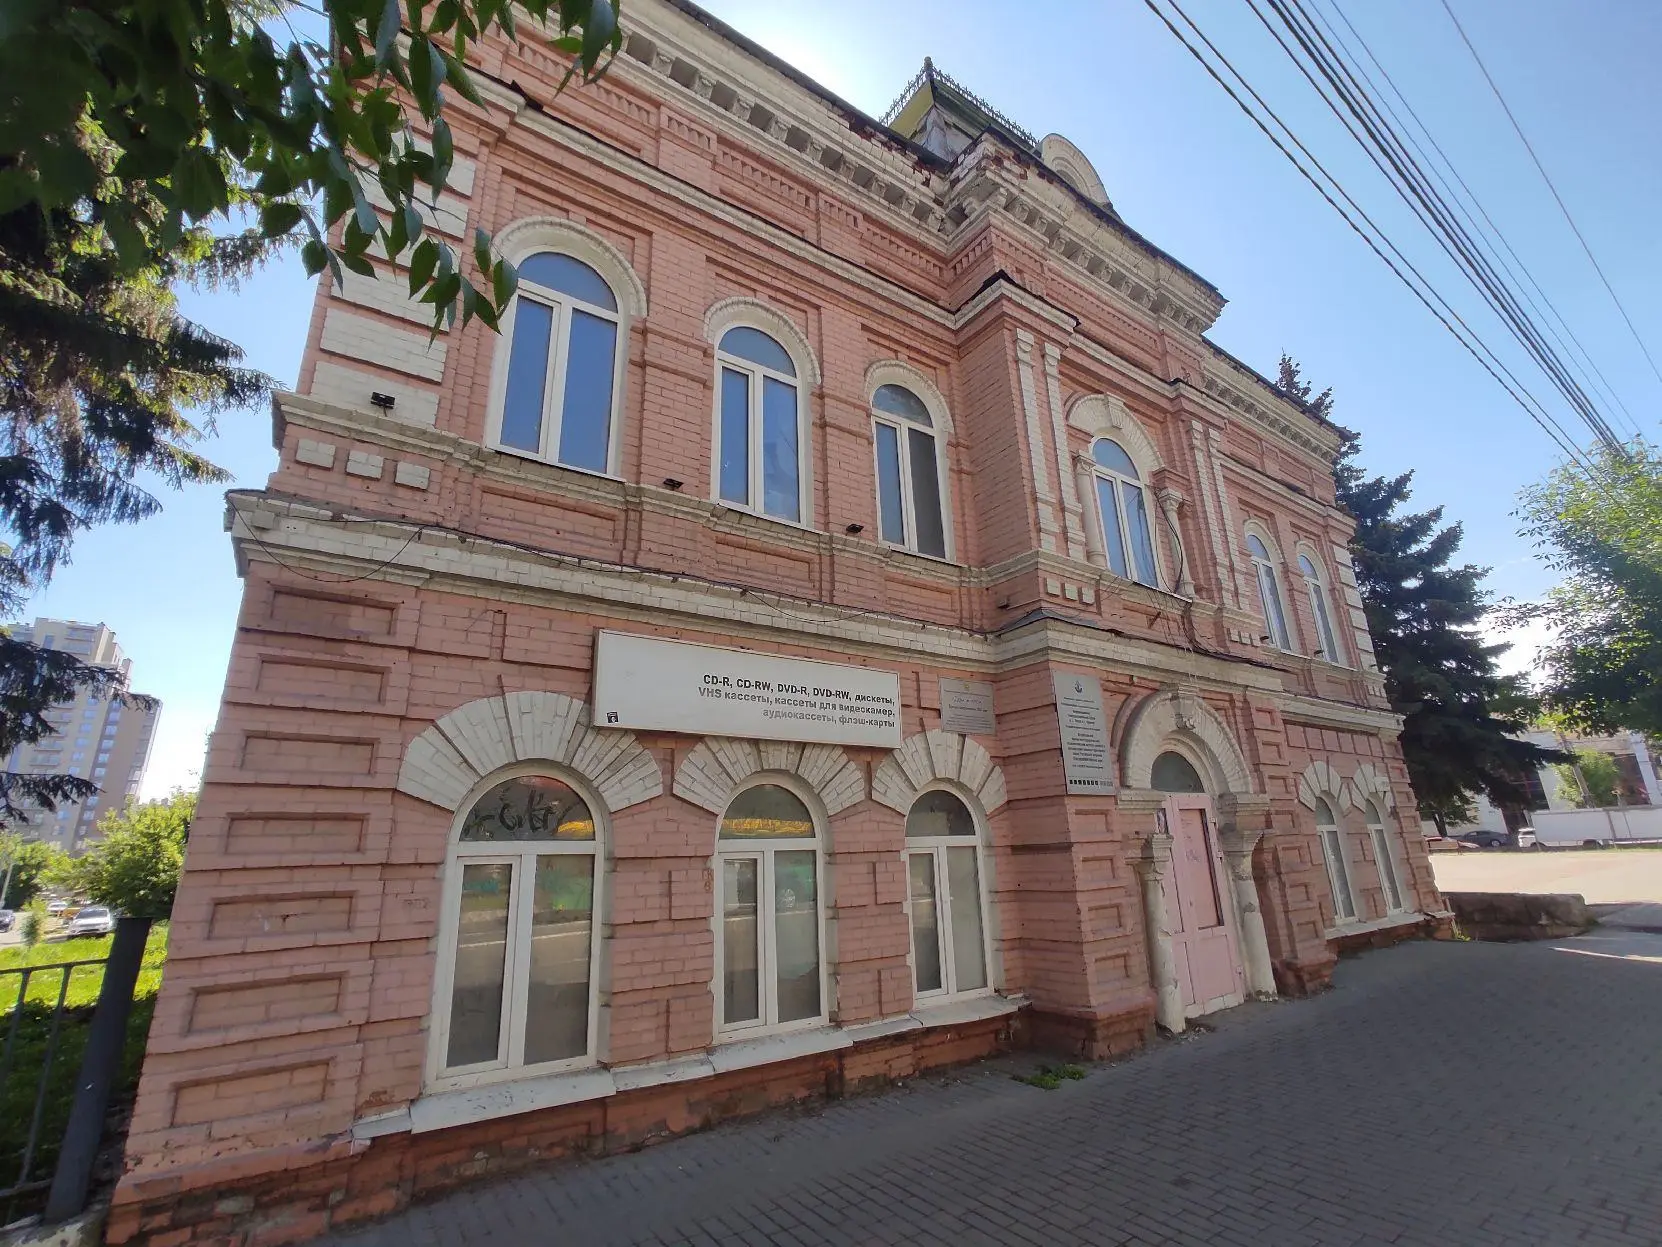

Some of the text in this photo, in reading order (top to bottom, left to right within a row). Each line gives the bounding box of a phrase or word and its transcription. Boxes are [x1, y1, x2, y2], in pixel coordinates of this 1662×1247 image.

[698, 686, 722, 698] VHS
[724, 692, 773, 705] кассеты,
[774, 697, 817, 709] кассеты
[819, 702, 837, 711] для
[703, 674, 895, 706] CD-R, CD-RW, DVD-R, DVD-RW, дискеты,
[763, 709, 895, 729] аудиокассеты, флэш-карты
